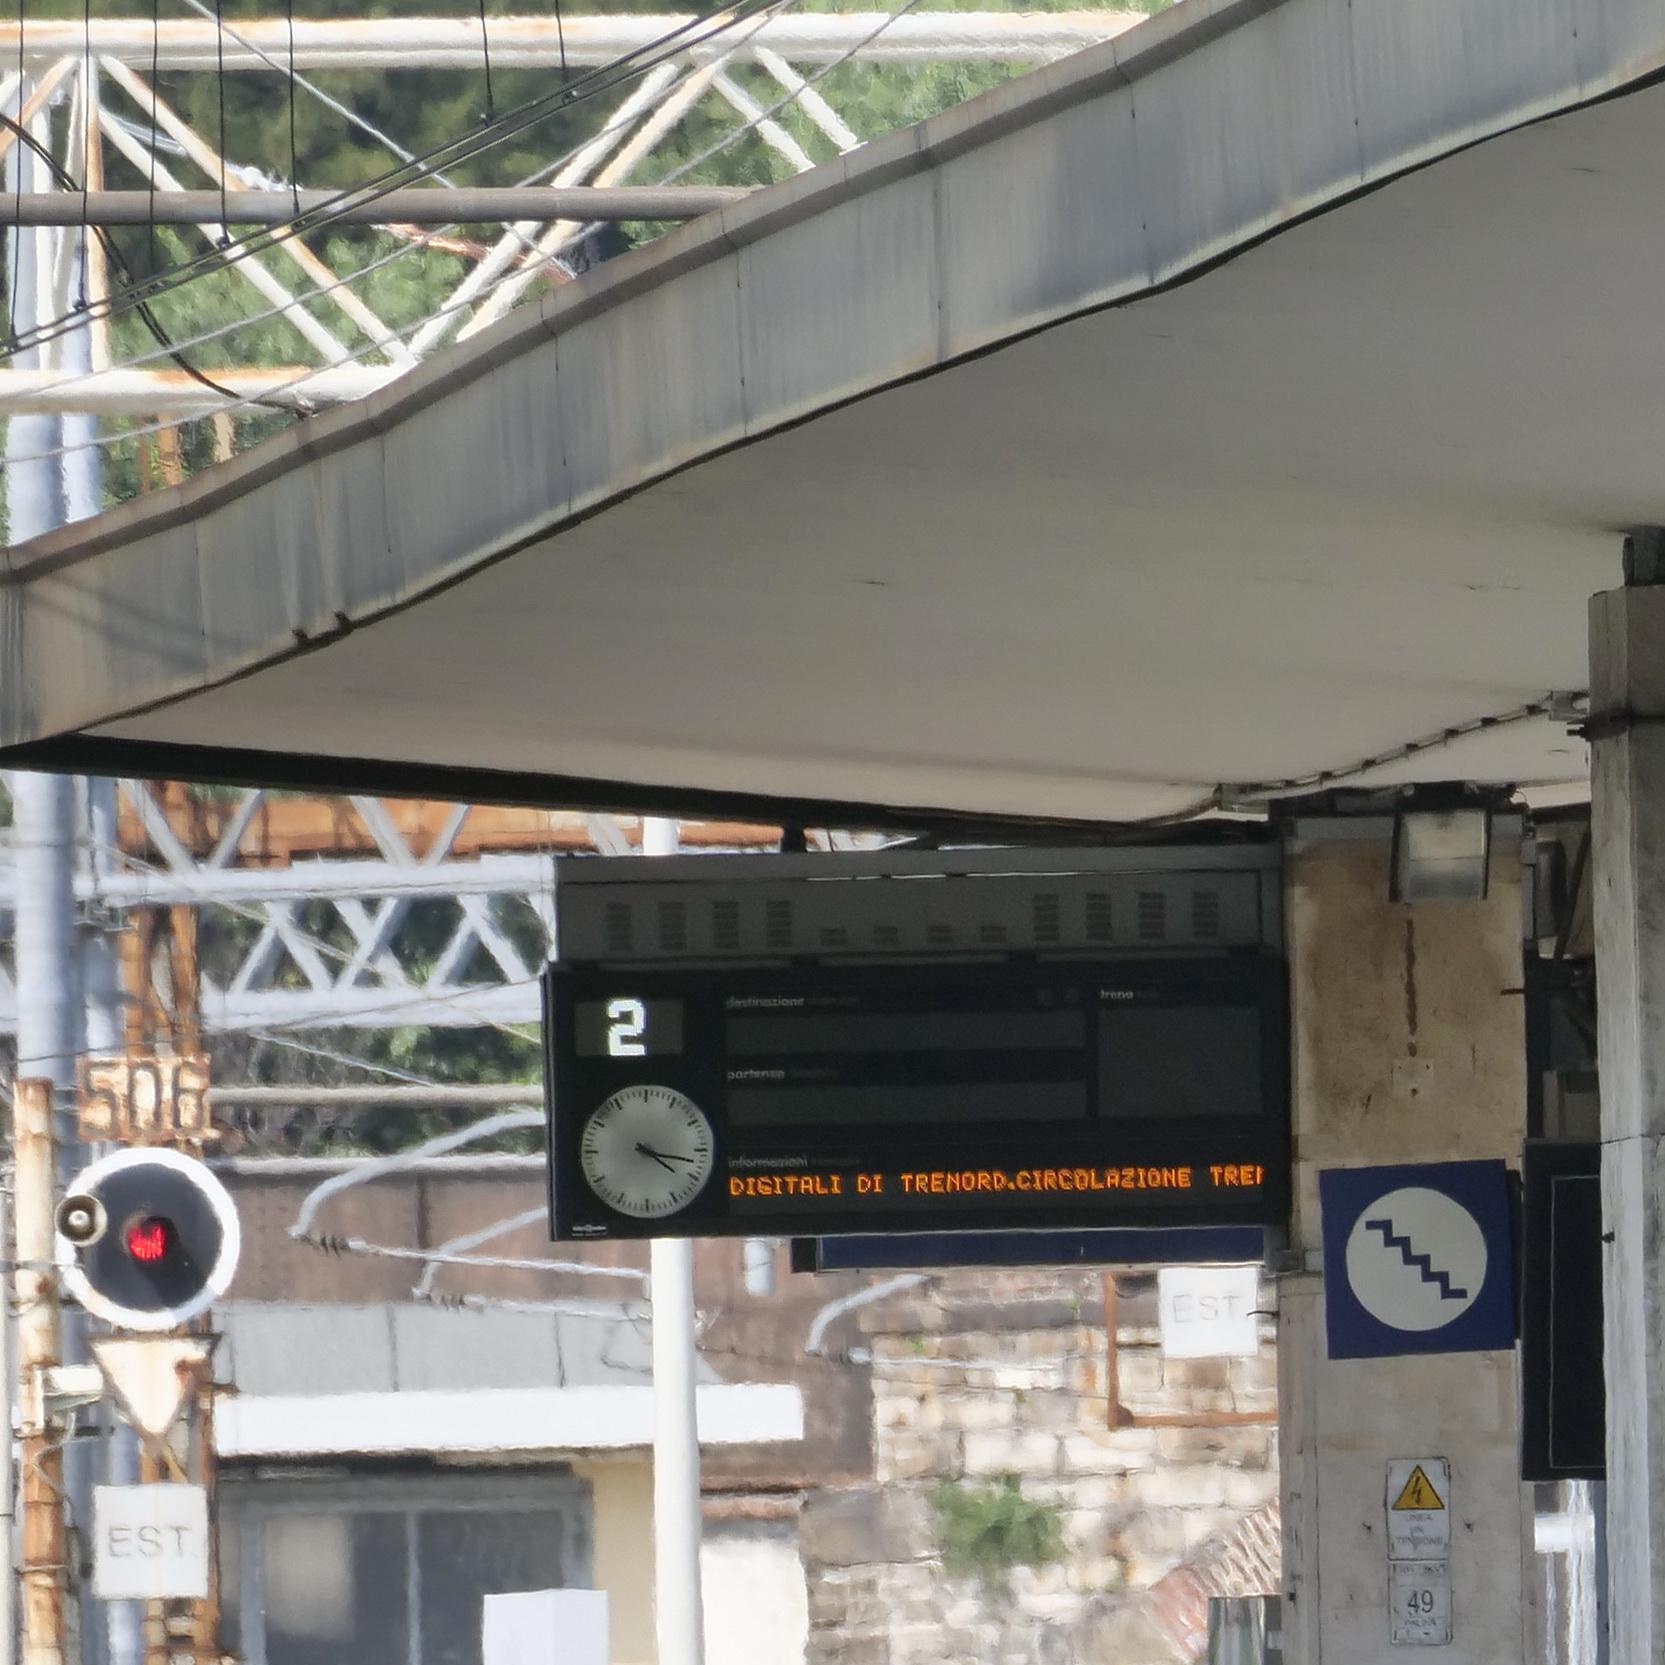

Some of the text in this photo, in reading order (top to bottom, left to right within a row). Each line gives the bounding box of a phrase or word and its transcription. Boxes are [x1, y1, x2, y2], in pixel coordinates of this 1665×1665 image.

[608, 999, 646, 1055] 2
[729, 1173, 842, 1196] DIGITALI
[856, 1173, 883, 1194] DI
[1173, 1293, 1241, 1323] EST
[1407, 1590, 1434, 1613] 49
